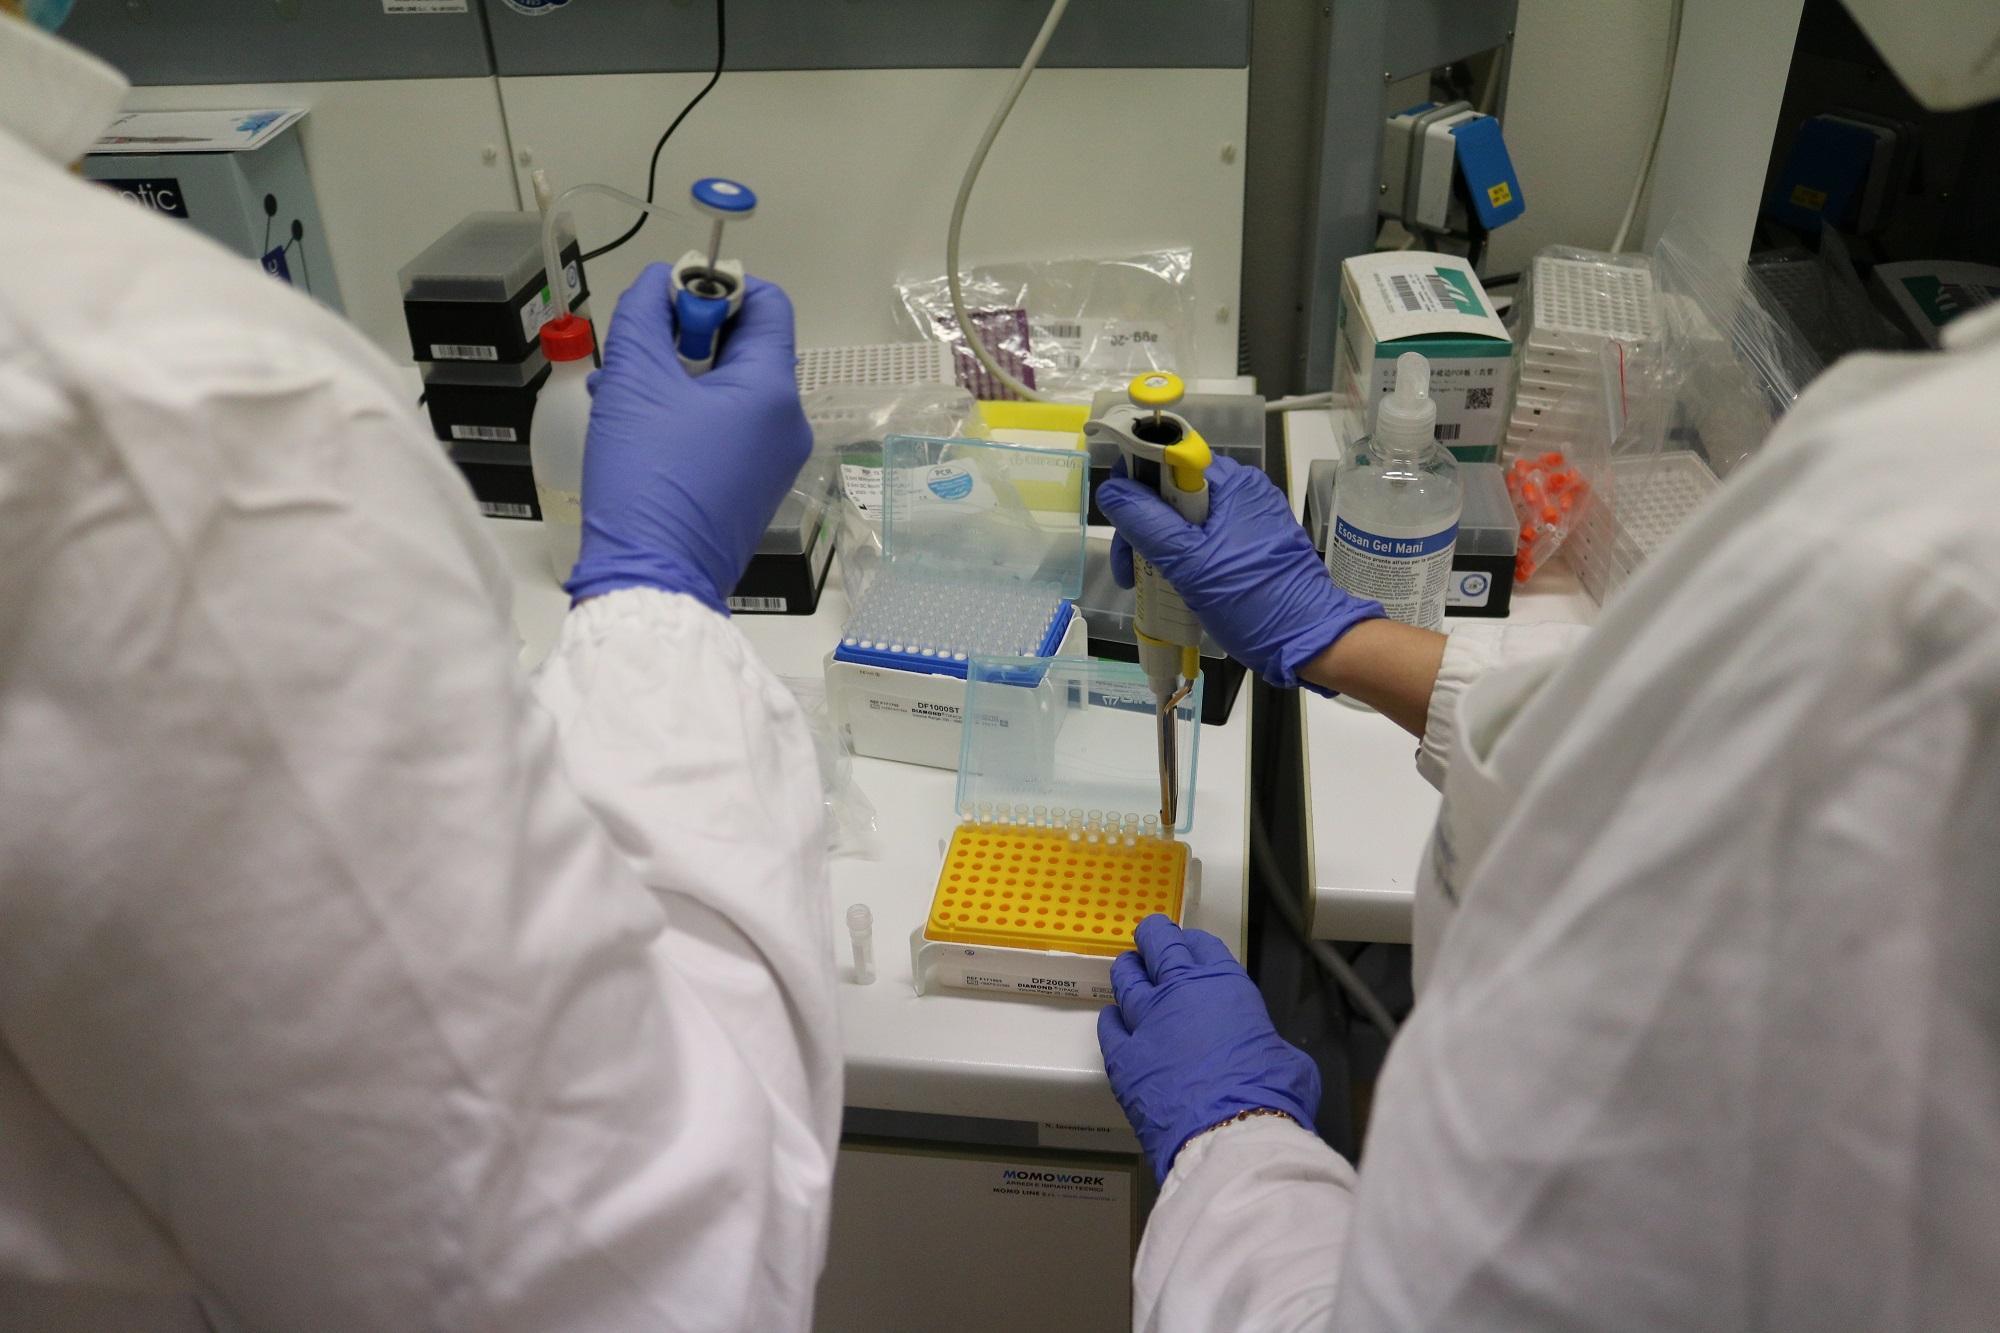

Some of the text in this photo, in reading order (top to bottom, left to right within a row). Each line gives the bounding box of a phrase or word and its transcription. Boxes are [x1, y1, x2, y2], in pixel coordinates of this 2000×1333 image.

[934, 468, 953, 477] PCR
[1338, 522, 1424, 554] Esosan Gel Mani
[917, 701, 960, 715] DF1000ST
[1031, 977, 1077, 988] DF200ST
[1003, 1170, 1105, 1186] MOMOWORK
[993, 1187, 1020, 1195] MOMO
[1041, 1183, 1073, 1191] IMPIANTI
